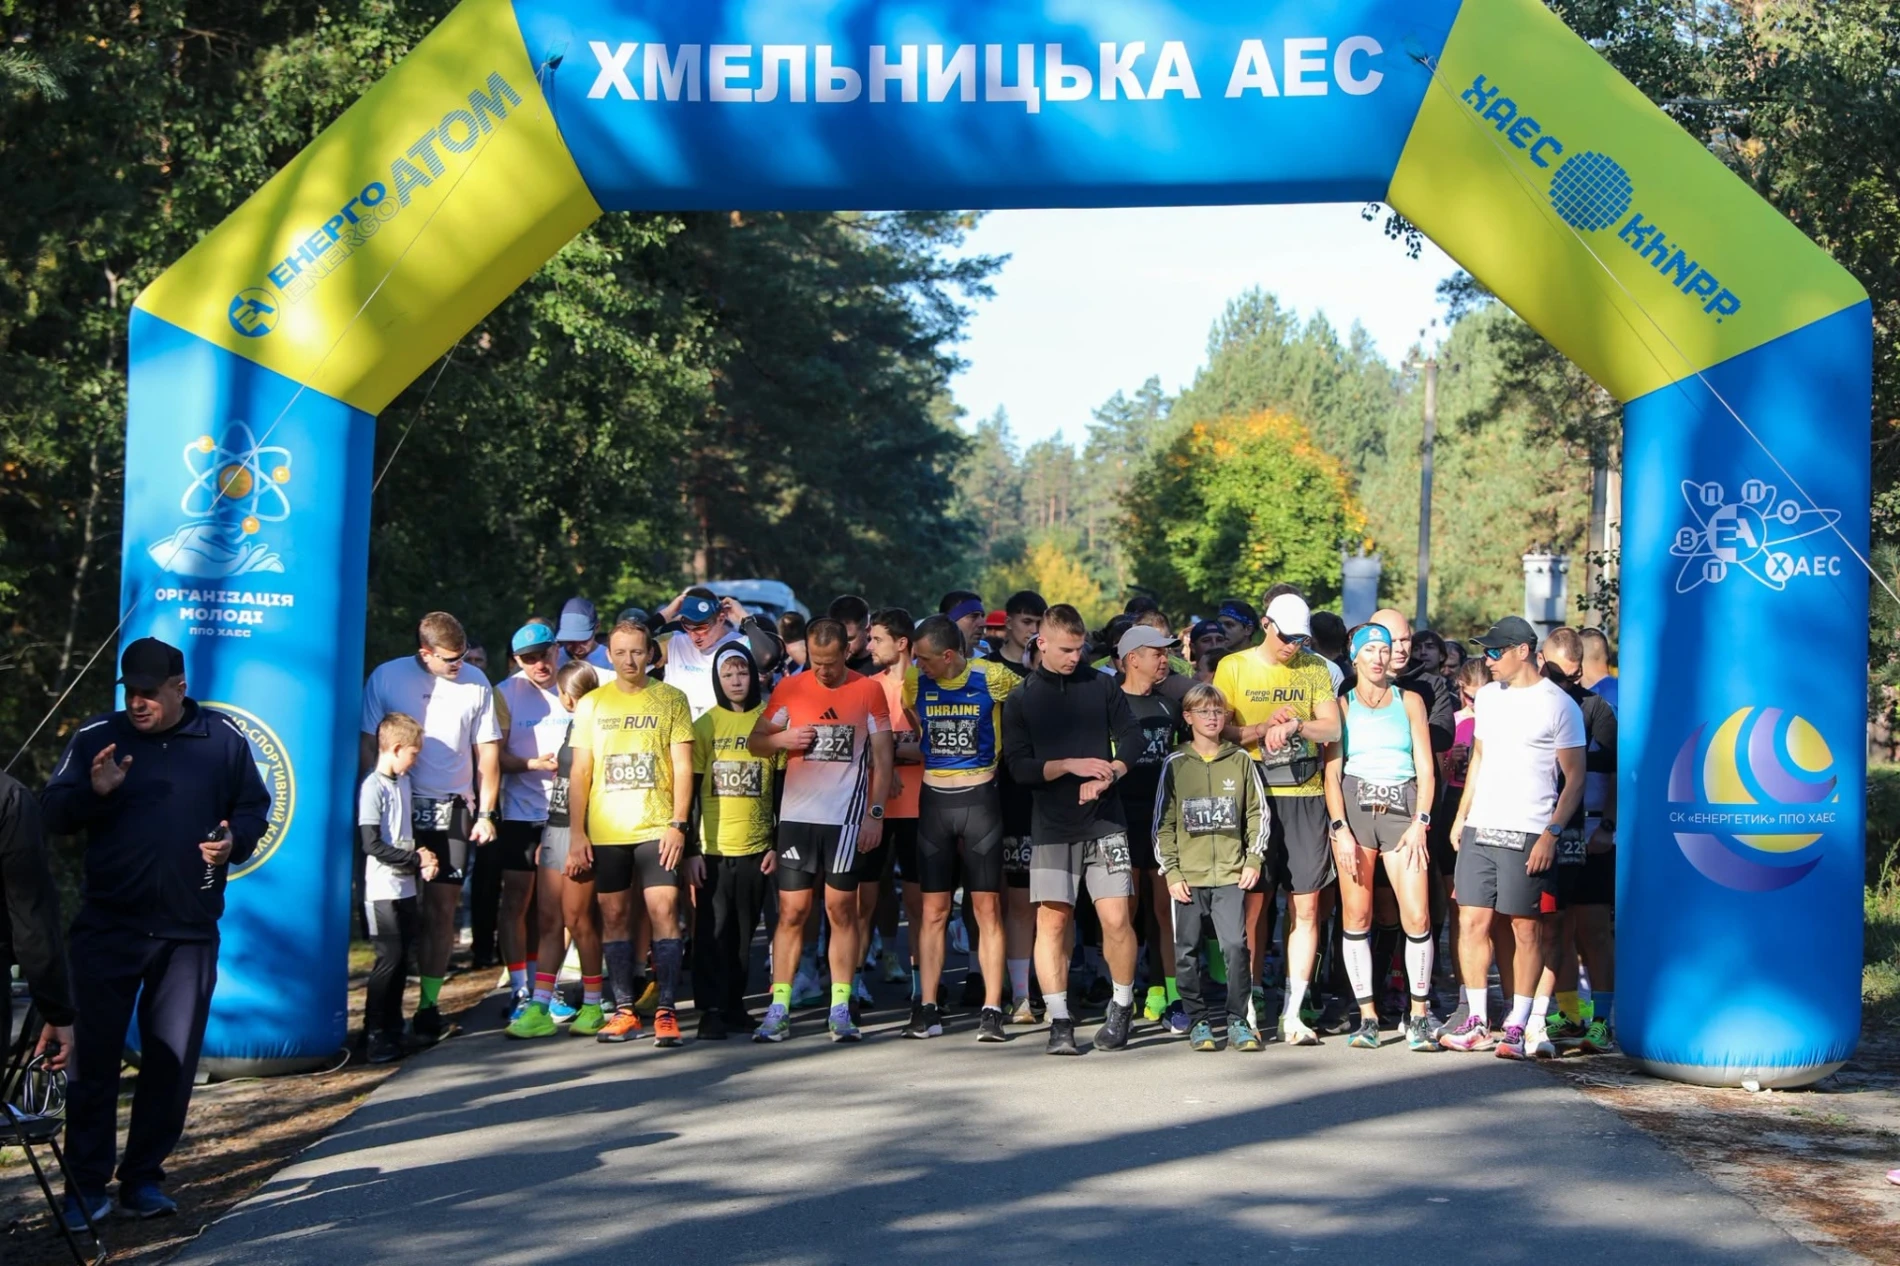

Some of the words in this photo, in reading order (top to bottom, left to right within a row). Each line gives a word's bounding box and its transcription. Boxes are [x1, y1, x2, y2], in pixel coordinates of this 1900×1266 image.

[587, 40, 1202, 113] ХМЕЛЬНИЦЬКА
[1224, 35, 1385, 99] АЕС
[1460, 74, 1564, 168] ХАЕС
[390, 71, 522, 208] АТОМ
[267, 181, 387, 290] ЕНЕРГО
[281, 196, 400, 305] ENERGO
[155, 588, 294, 607] ОРГАНІЗАЦІЯ
[179, 607, 264, 625] МОЛОДІ
[189, 627, 215, 636] ППО
[217, 628, 251, 638] ХАЕС
[1245, 689, 1271, 697] Energo
[1273, 689, 1304, 702] RUN
[624, 715, 658, 729] RUN
[813, 738, 845, 752] 227
[937, 732, 969, 747] 256
[1143, 741, 1164, 754] 41
[612, 765, 648, 781] 089
[721, 772, 752, 787] 104
[1366, 785, 1399, 801] 205
[1195, 810, 1224, 824] 114
[1669, 812, 1685, 823] СК
[1687, 813, 1775, 825] «ЕНЕРГЕТИК»
[1779, 813, 1805, 824] ППО
[1808, 812, 1836, 823] ХАЕС
[1003, 848, 1031, 861] 046
